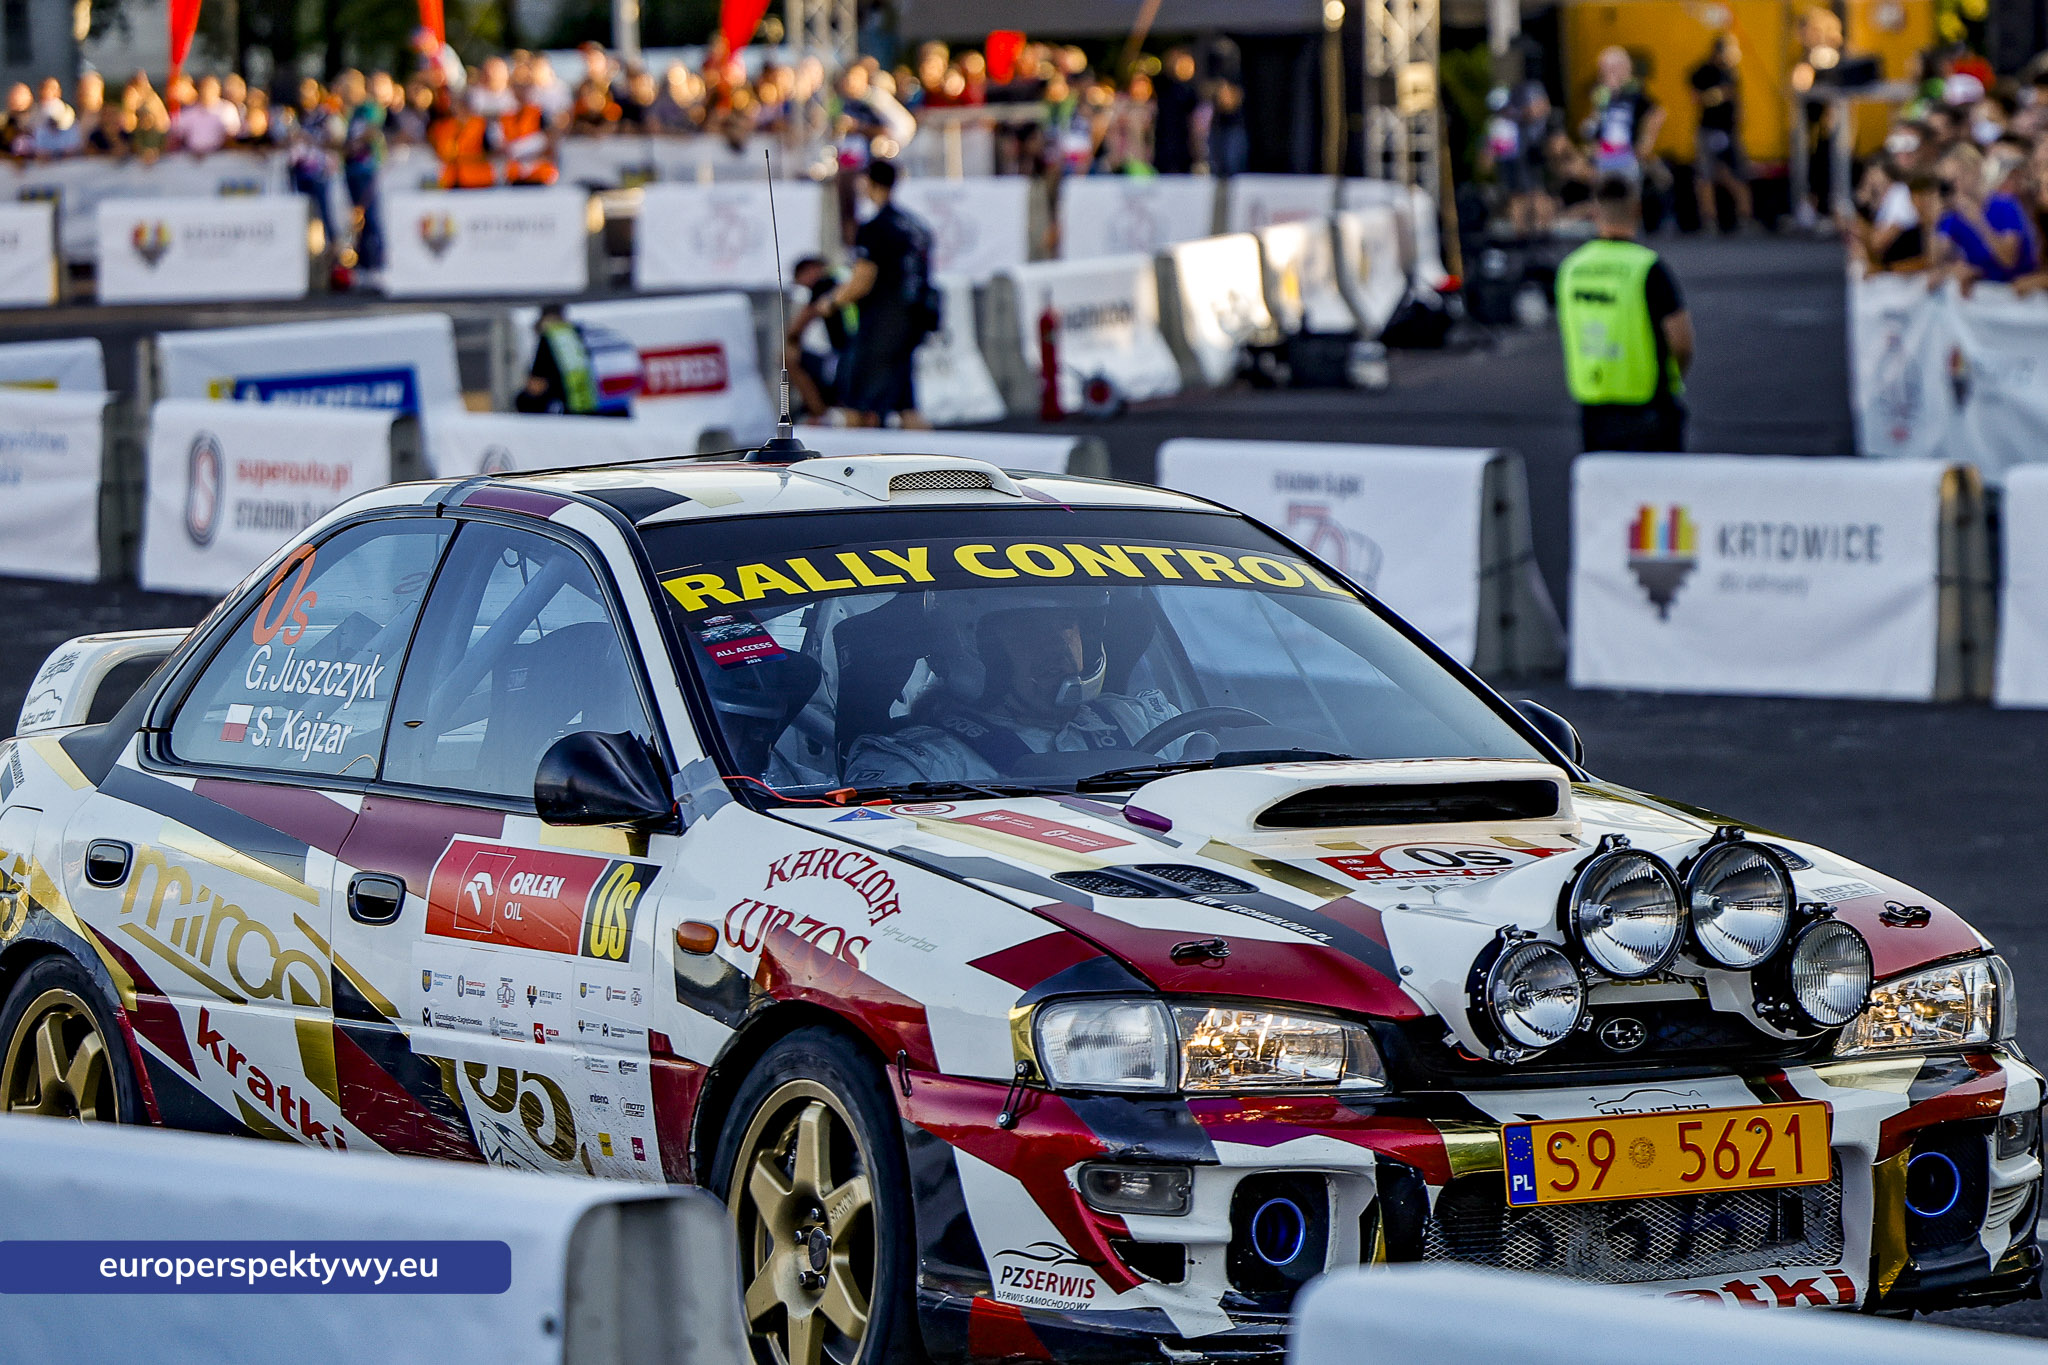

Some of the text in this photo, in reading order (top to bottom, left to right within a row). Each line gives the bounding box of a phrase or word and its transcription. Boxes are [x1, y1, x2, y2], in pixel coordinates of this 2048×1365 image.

[661, 542, 1358, 612] RALLY CONTROL
[716, 650, 735, 658] ALL
[736, 641, 773, 654] ACCESS
[245, 644, 385, 710] G.Juszczyk
[251, 705, 354, 762] S. Kajzar
[509, 872, 566, 899] ORLEN
[764, 847, 902, 927] KARCZMA
[504, 902, 523, 921] OIL
[1223, 904, 1334, 942] TECHNOLOGY.PL
[724, 897, 873, 987] WRZOS
[197, 1005, 348, 1152] kratki
[1547, 1113, 1803, 1192] S9 5621
[1513, 1176, 1533, 1192] PL
[1001, 1265, 1096, 1299] PZSERWIS
[1025, 1295, 1091, 1311] SAMOCHODOWY
